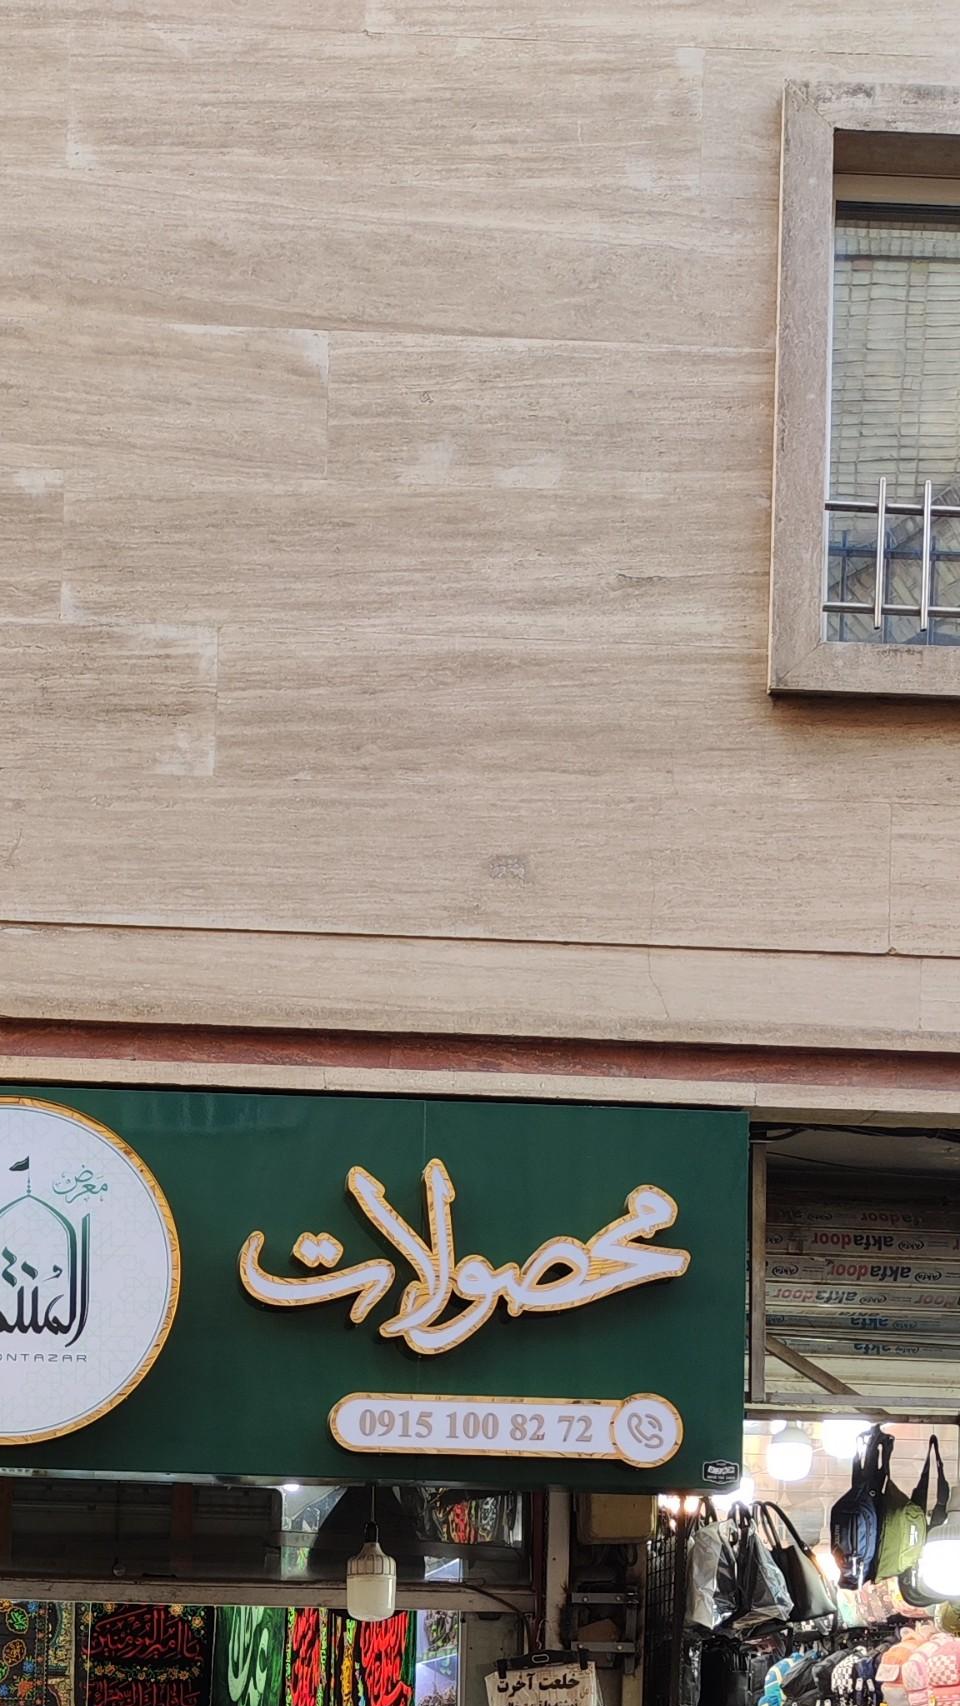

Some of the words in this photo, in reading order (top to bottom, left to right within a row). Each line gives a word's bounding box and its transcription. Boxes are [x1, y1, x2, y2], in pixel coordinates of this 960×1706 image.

[812, 1232, 894, 1251] akfadoor
[238, 1158, 692, 1354] محصولات
[827, 1263, 912, 1282] akfadoor
[359, 1409, 433, 1439] 0915
[445, 1412, 500, 1440] 100
[510, 1413, 546, 1441] 82
[557, 1414, 594, 1443] 72
[496, 1674, 536, 1697] آخرت
[538, 1673, 581, 1691] خلعت
